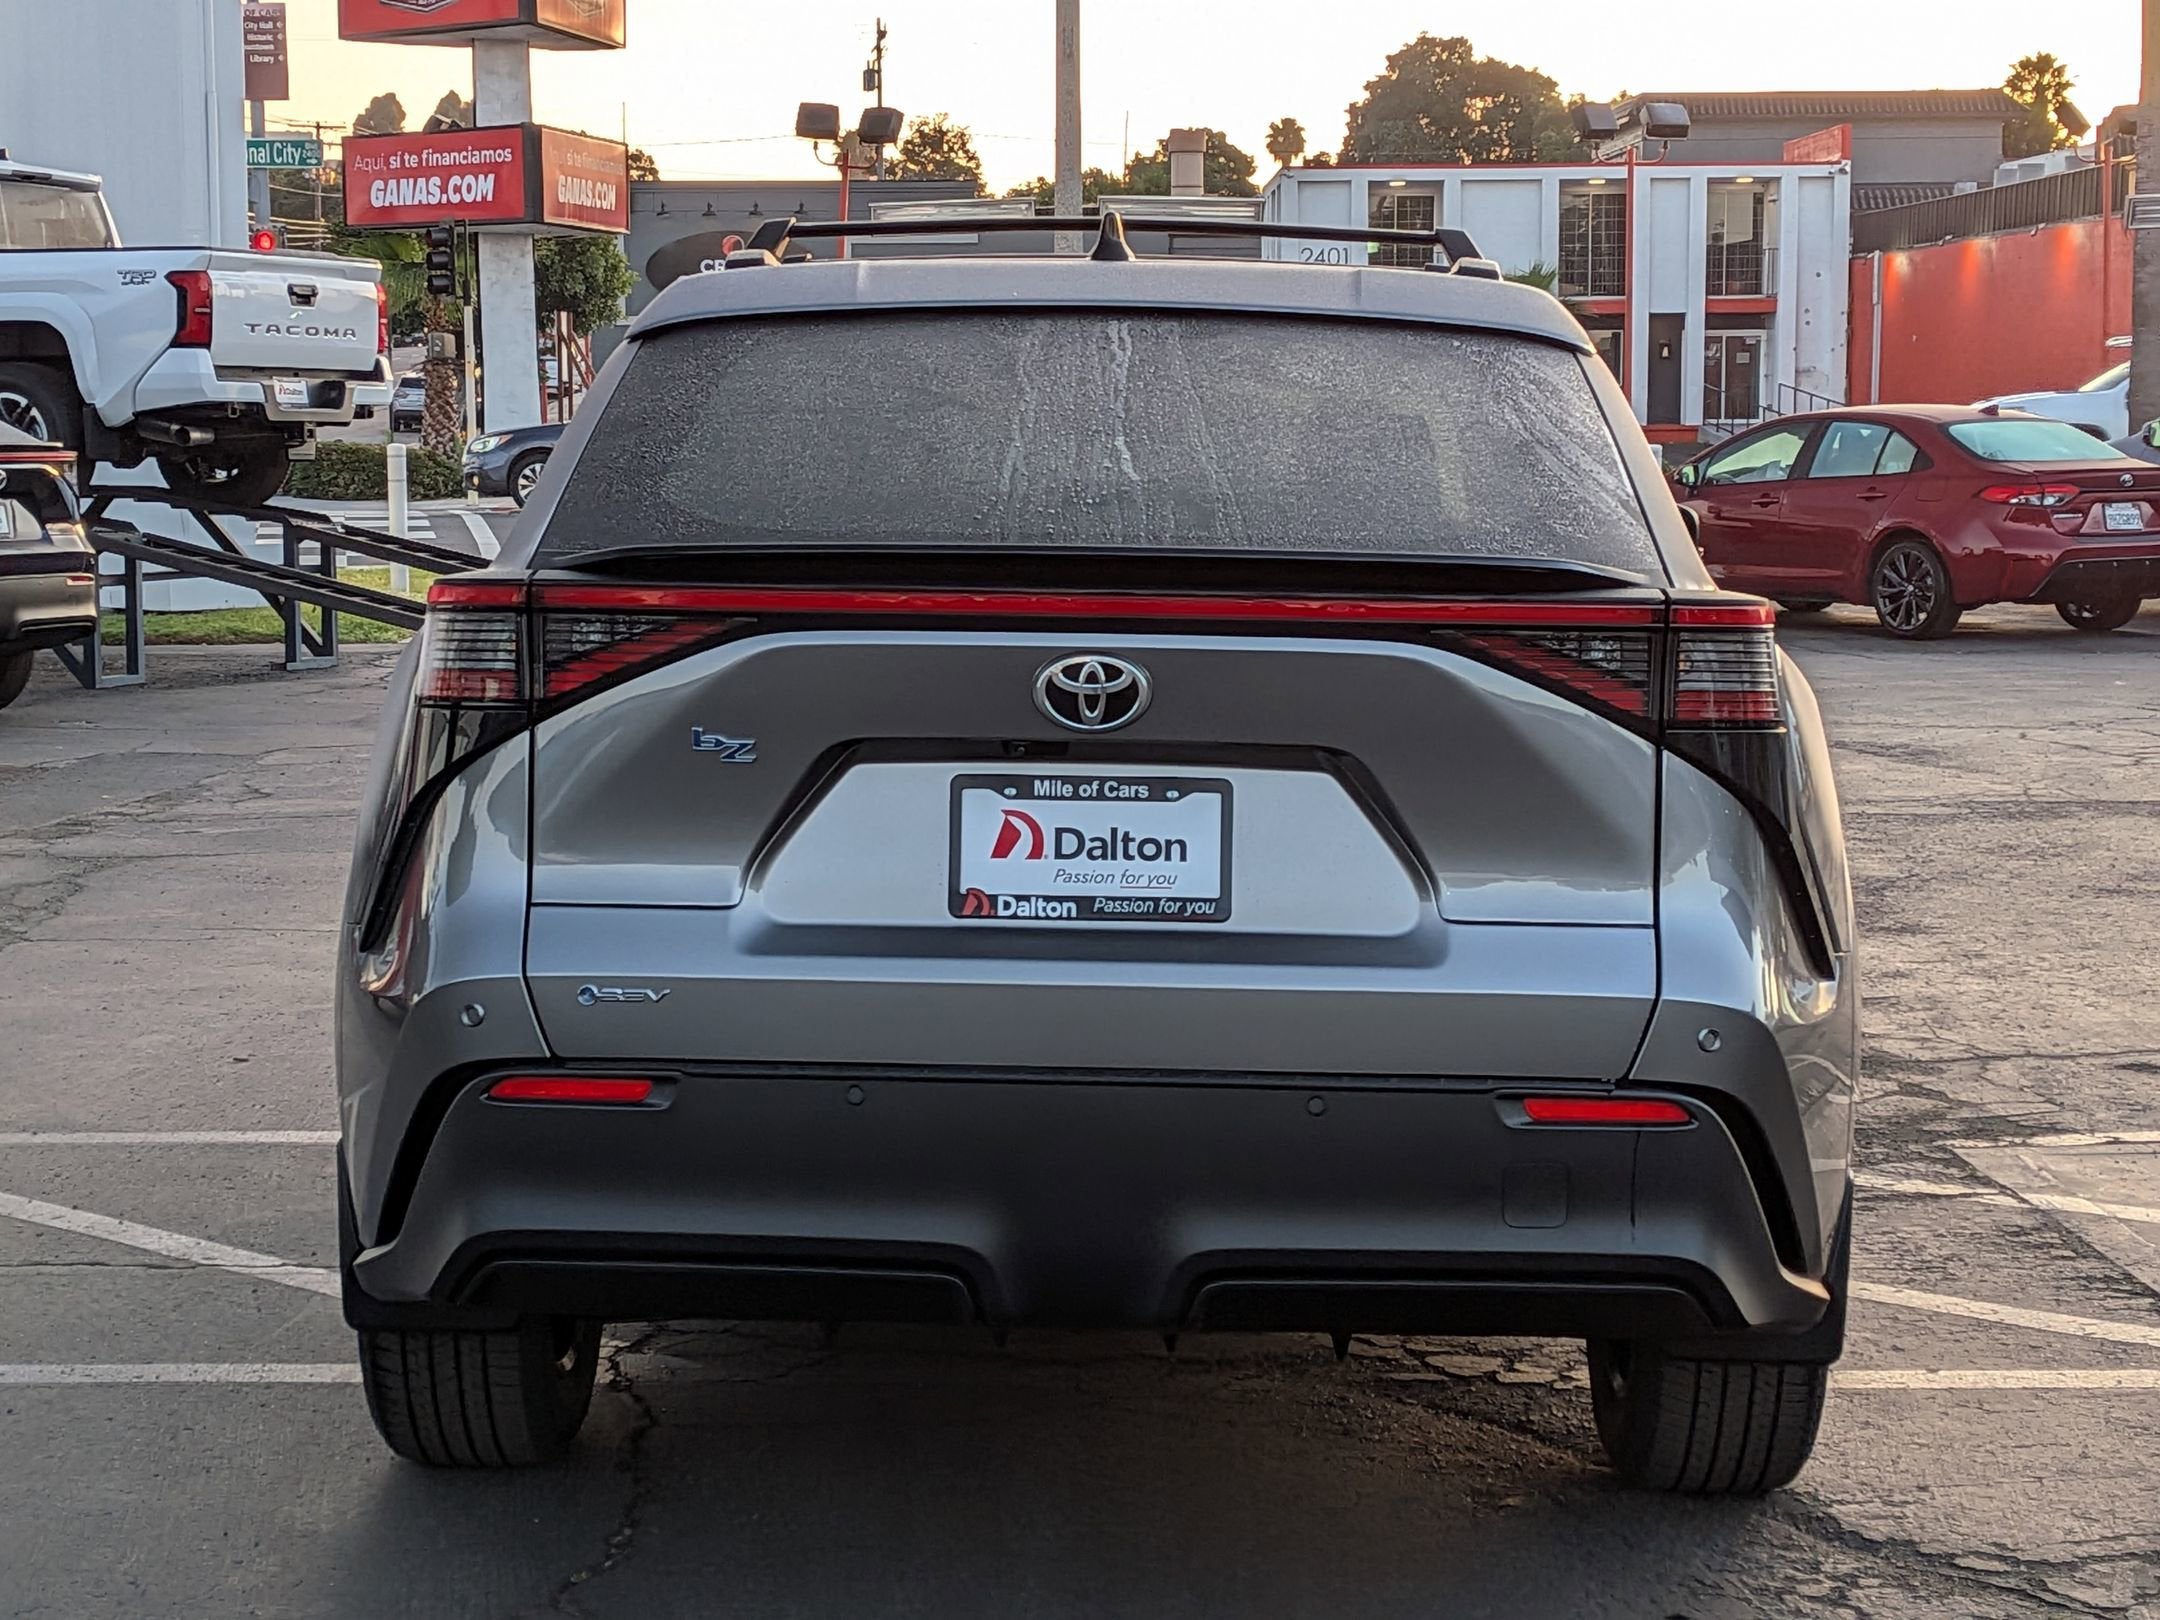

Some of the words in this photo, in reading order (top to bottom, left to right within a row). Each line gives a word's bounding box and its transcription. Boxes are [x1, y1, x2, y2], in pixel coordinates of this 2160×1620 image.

[273, 142, 302, 165] City
[404, 152, 419, 168] te
[421, 146, 513, 167] financiamos
[370, 173, 496, 208] GANAS.COM
[558, 174, 617, 212] GANAS.COM
[1300, 247, 1349, 265] 2401
[243, 322, 357, 340] TACOMA
[1033, 779, 1073, 798] Mile
[1078, 779, 1099, 798] of
[1103, 780, 1150, 799] Cars
[1053, 826, 1188, 863] Dalton
[1053, 868, 1115, 885] Passion
[1119, 868, 1145, 887] for
[1147, 873, 1178, 888] you
[997, 895, 1078, 918] Dalton
[1092, 897, 1154, 914] Passion
[1156, 898, 1182, 915] for
[1183, 901, 1216, 917] you
